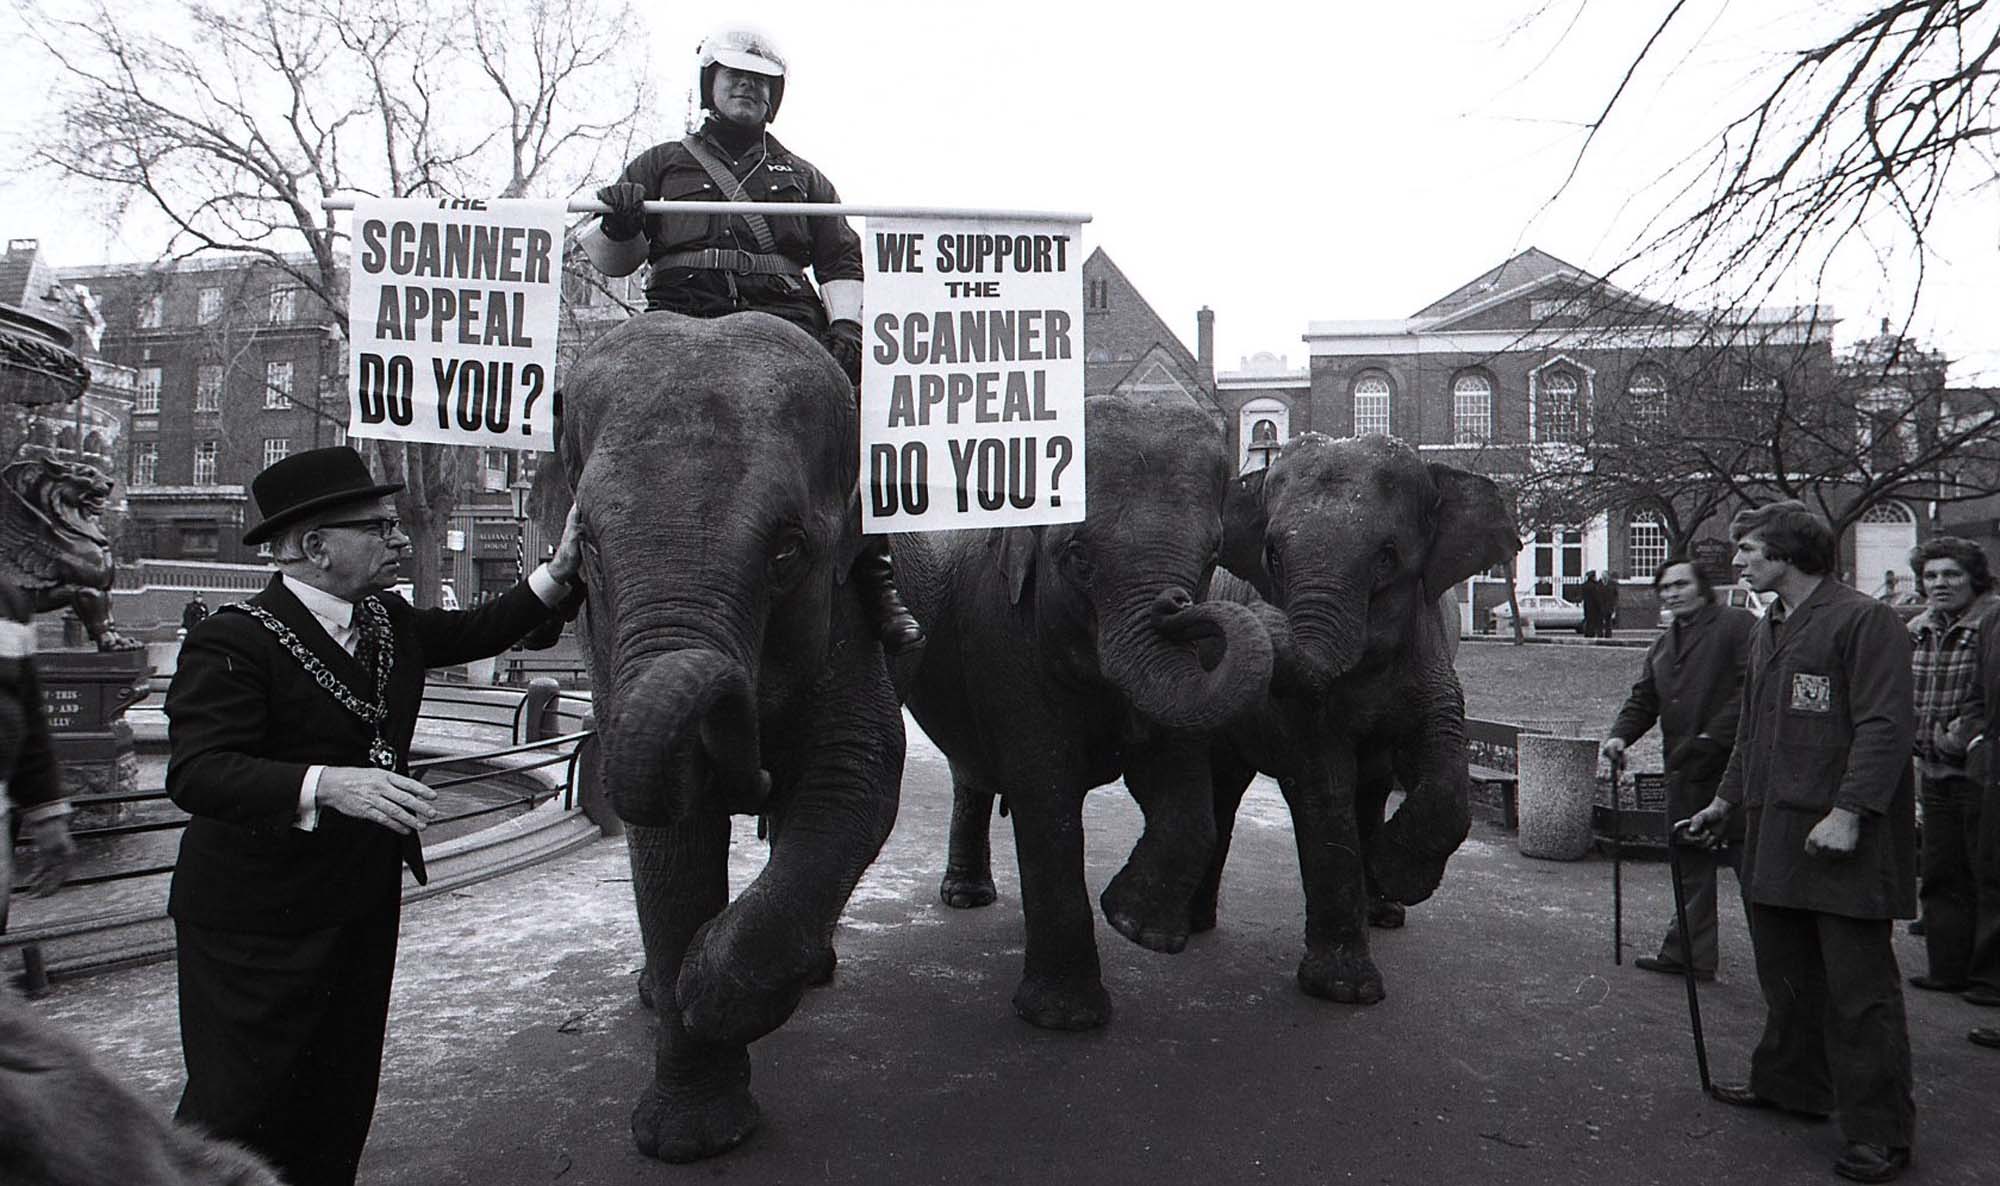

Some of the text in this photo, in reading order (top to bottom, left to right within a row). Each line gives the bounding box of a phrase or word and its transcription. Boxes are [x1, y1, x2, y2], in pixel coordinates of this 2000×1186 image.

[361, 219, 552, 284] SCANNER
[875, 232, 1071, 274] WE SUPPORT
[375, 284, 533, 348] APPEAL
[944, 281, 1001, 298] THE
[873, 310, 1072, 366] SCANNER
[359, 352, 545, 436] DO YOU?
[887, 370, 1057, 428] APPEAL
[870, 435, 1073, 518] DO YOU?
